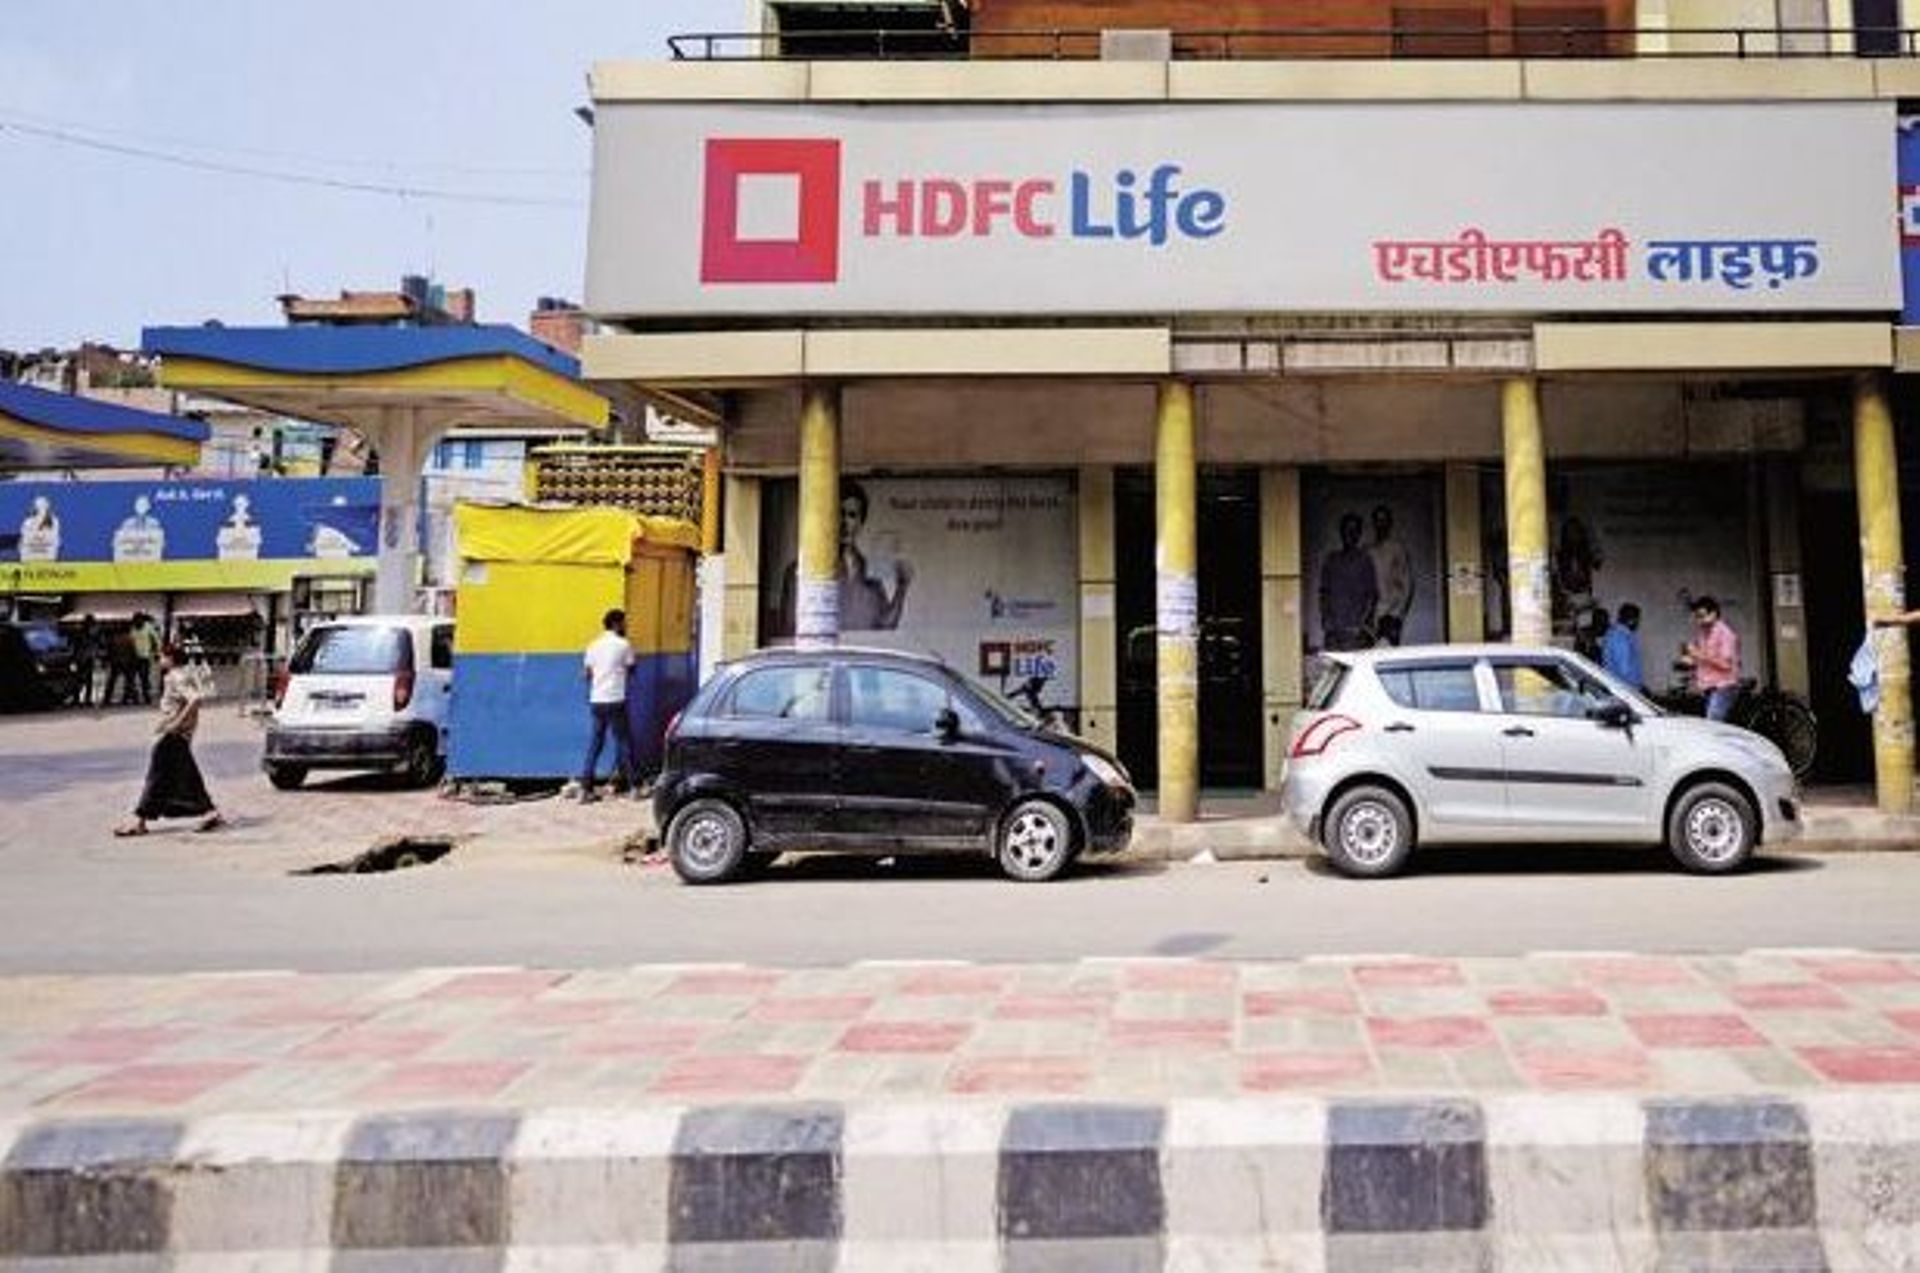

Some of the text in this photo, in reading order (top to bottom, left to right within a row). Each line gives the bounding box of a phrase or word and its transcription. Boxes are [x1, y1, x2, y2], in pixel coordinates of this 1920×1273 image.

[862, 164, 1226, 246] HDFC Life
[1372, 229, 1818, 289] एचडीएफसी लाइफ़
[1014, 655, 1057, 678] Life
